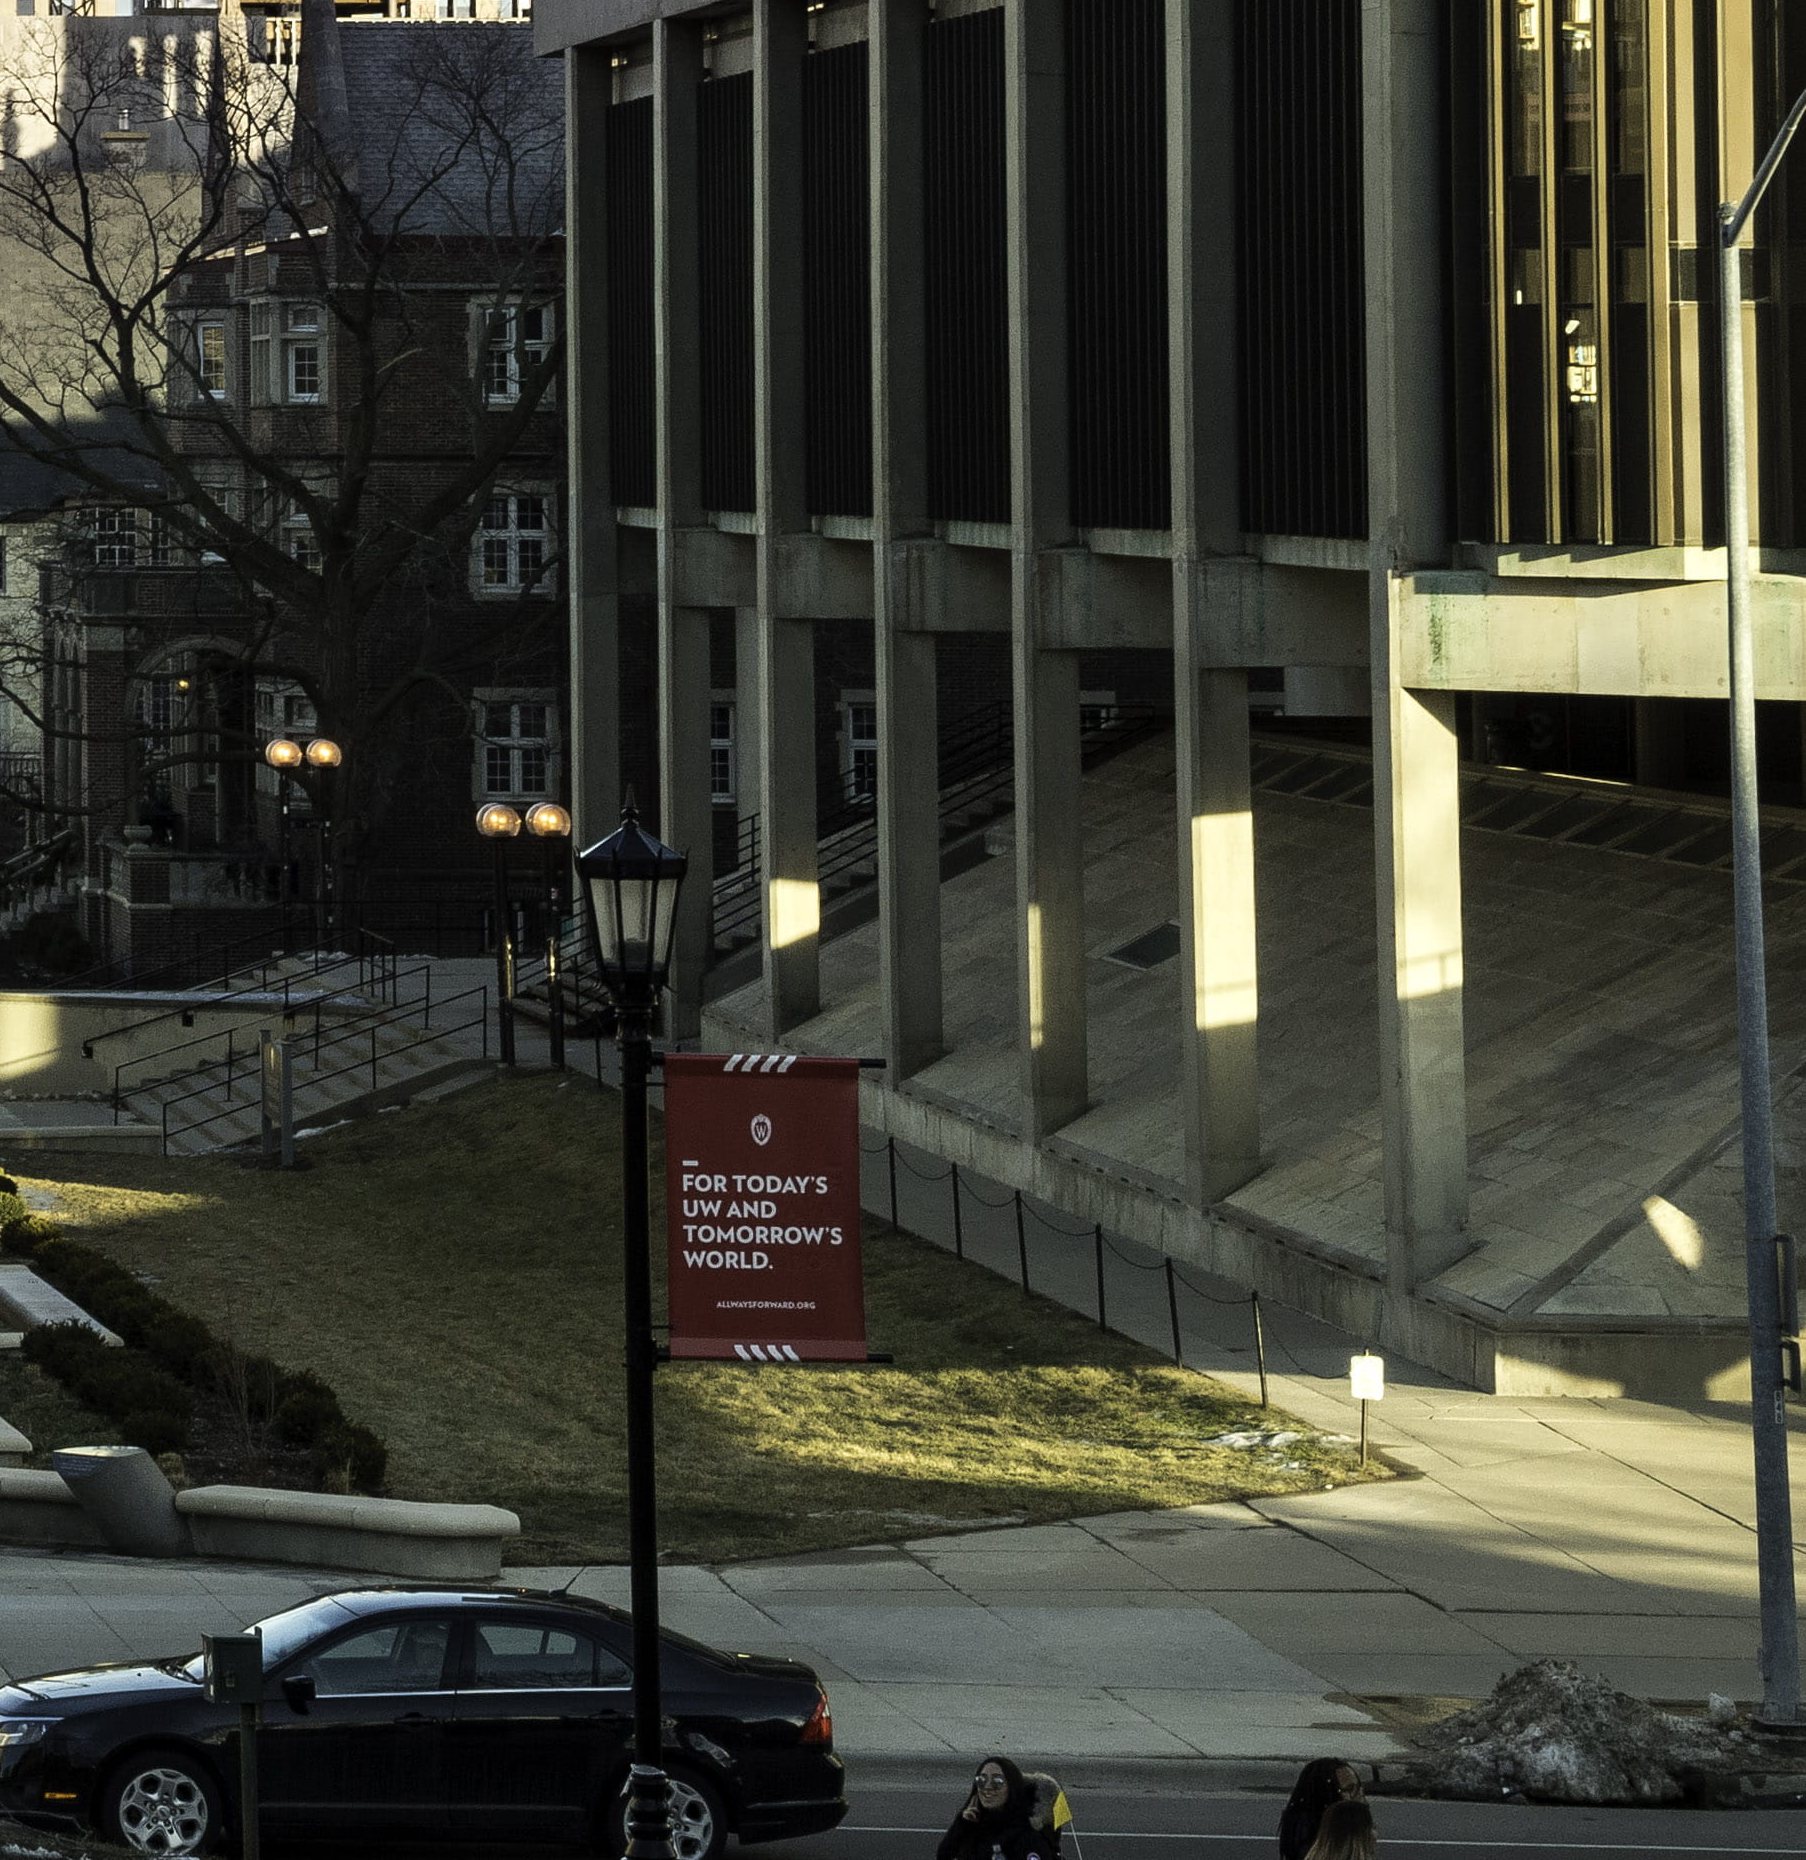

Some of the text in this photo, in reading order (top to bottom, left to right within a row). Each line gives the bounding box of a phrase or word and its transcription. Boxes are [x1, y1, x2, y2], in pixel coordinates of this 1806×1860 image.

[682, 1173, 828, 1195] FOR TODAY'S
[682, 1200, 777, 1219] UW AND
[682, 1224, 843, 1245] TOMORROW'S
[683, 1250, 774, 1270] WORLD.
[715, 1300, 817, 1310] ALLWAYSFORWARD.ORG
